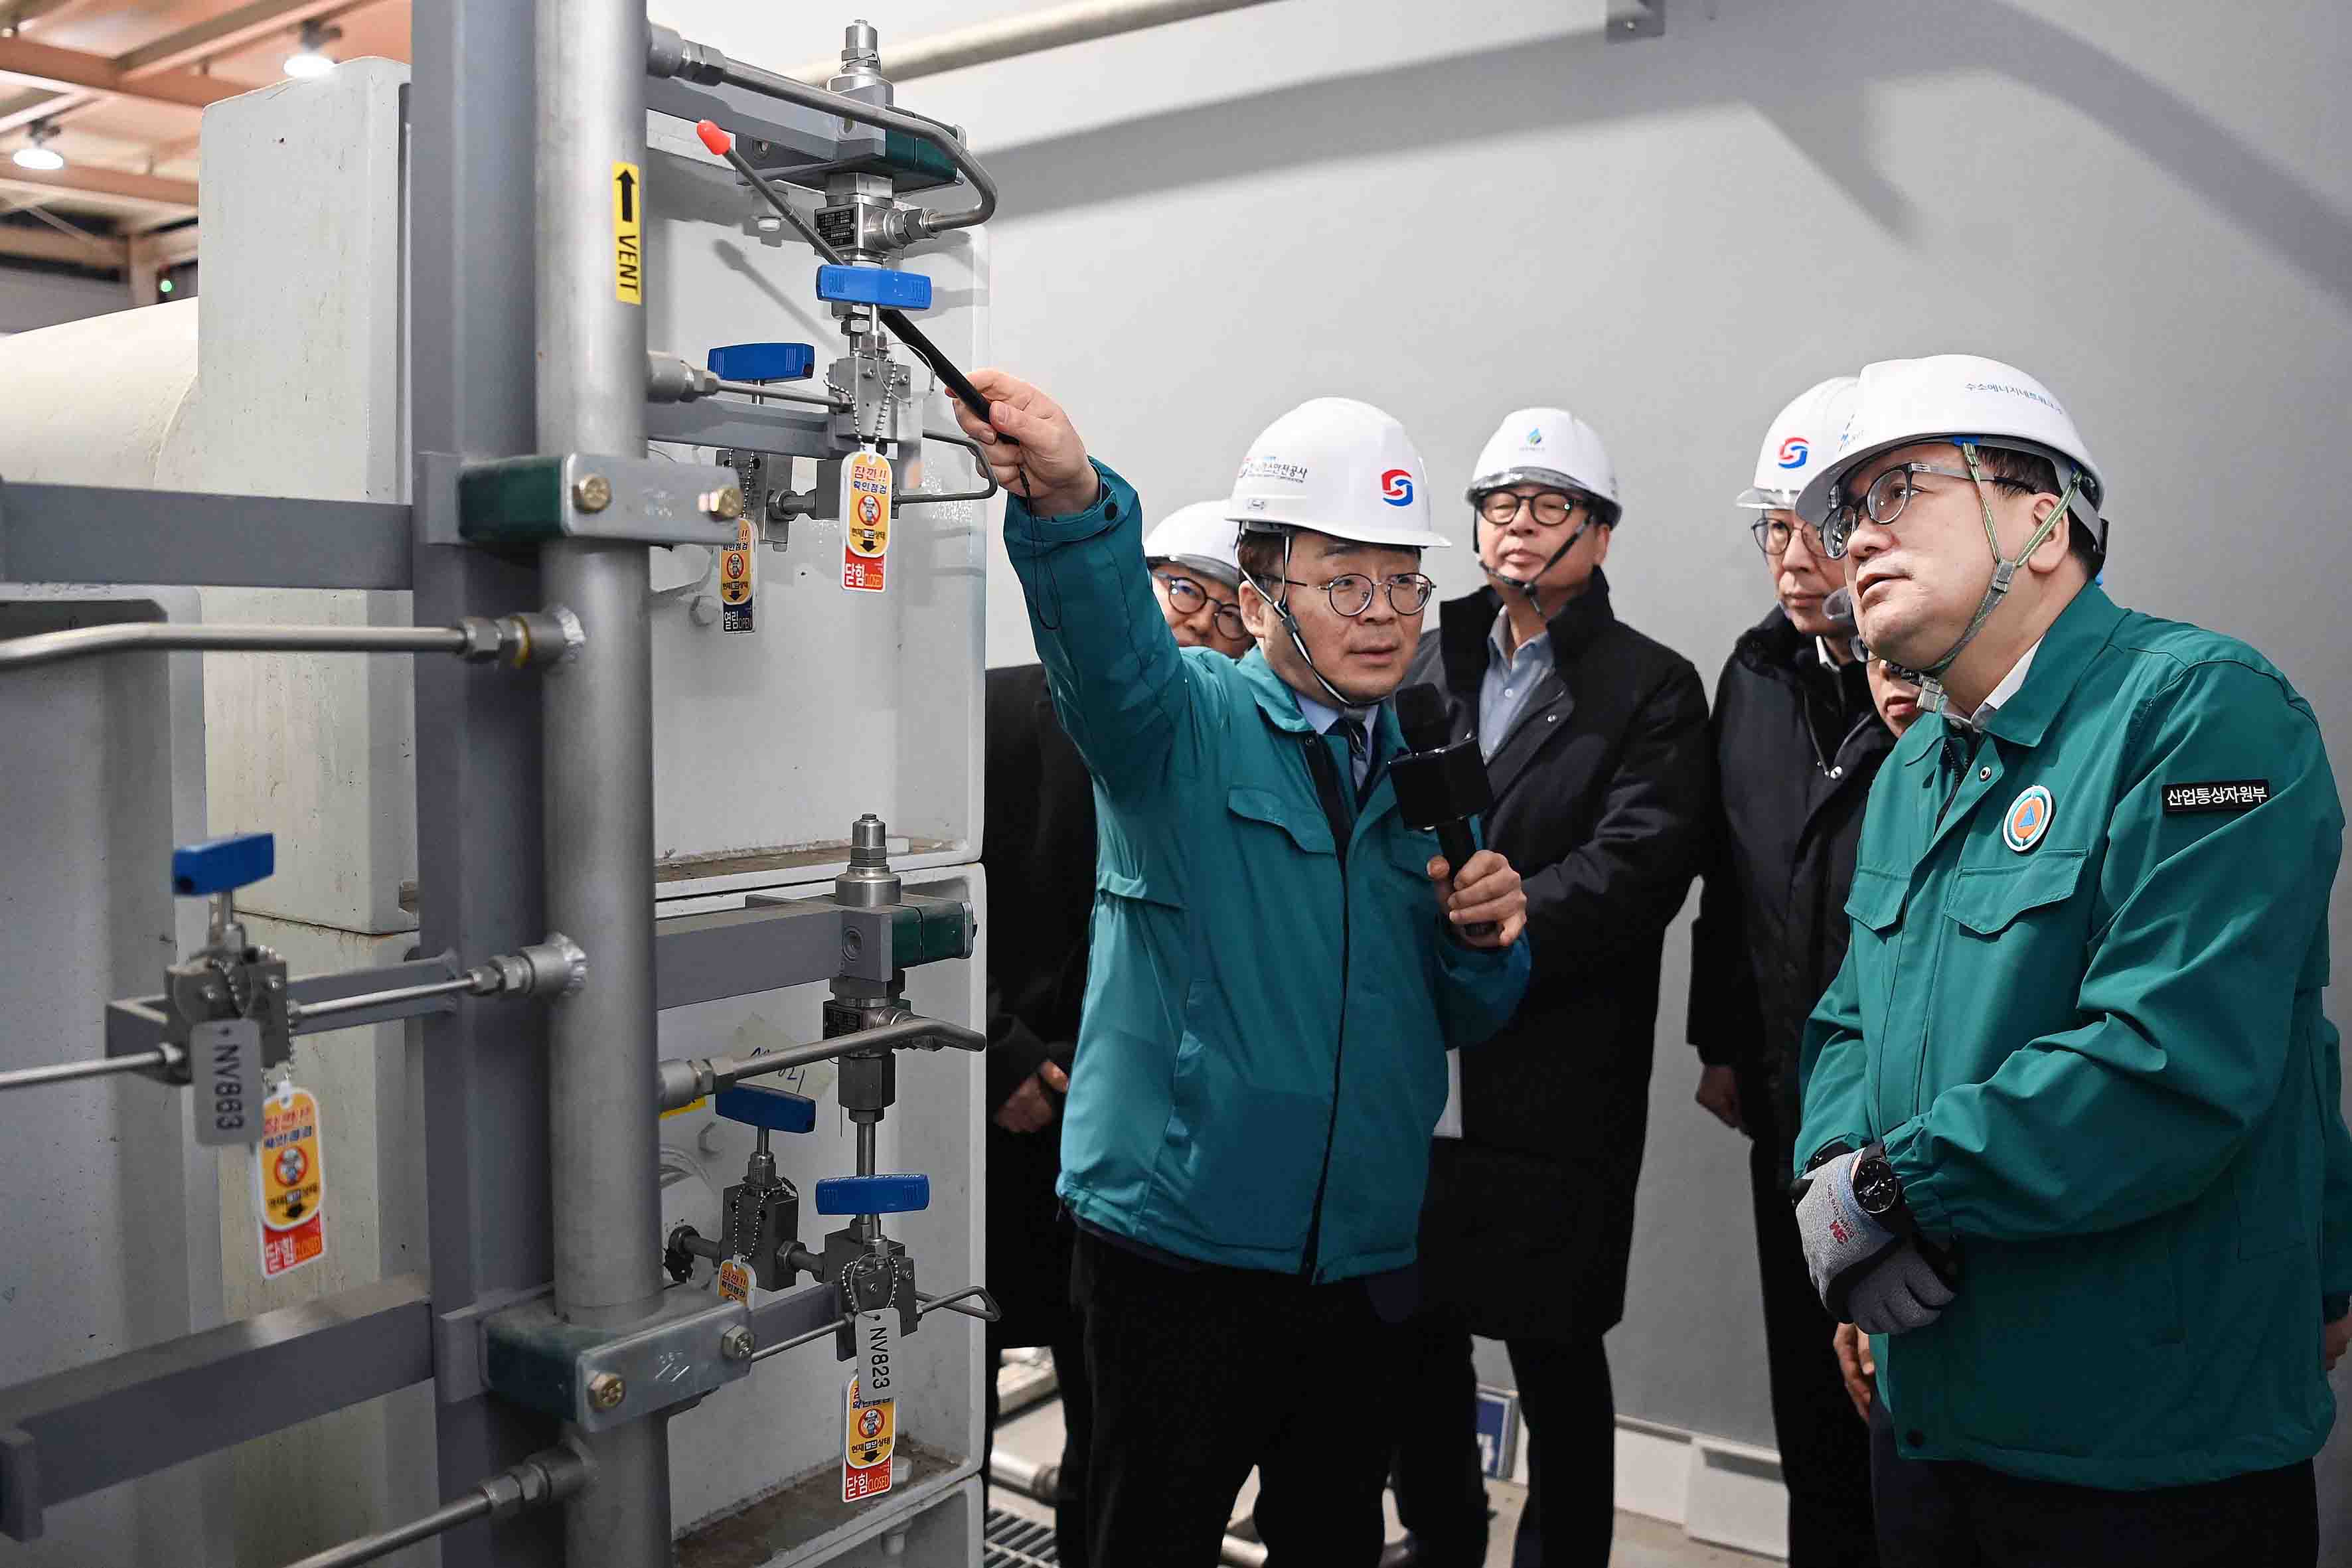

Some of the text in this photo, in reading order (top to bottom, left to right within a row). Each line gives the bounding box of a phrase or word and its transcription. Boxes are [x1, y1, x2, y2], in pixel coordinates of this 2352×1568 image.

[618, 234, 639, 296] VENT
[854, 465, 887, 481] 잠깐!!
[853, 481, 887, 495] 확인점검
[845, 563, 865, 586] 닫힘
[724, 611, 738, 630] 열림
[2167, 785, 2267, 806] 산업통상자원부
[870, 1327, 890, 1390] NV823
[846, 1472, 890, 1498] 닫힘 CLOSED
